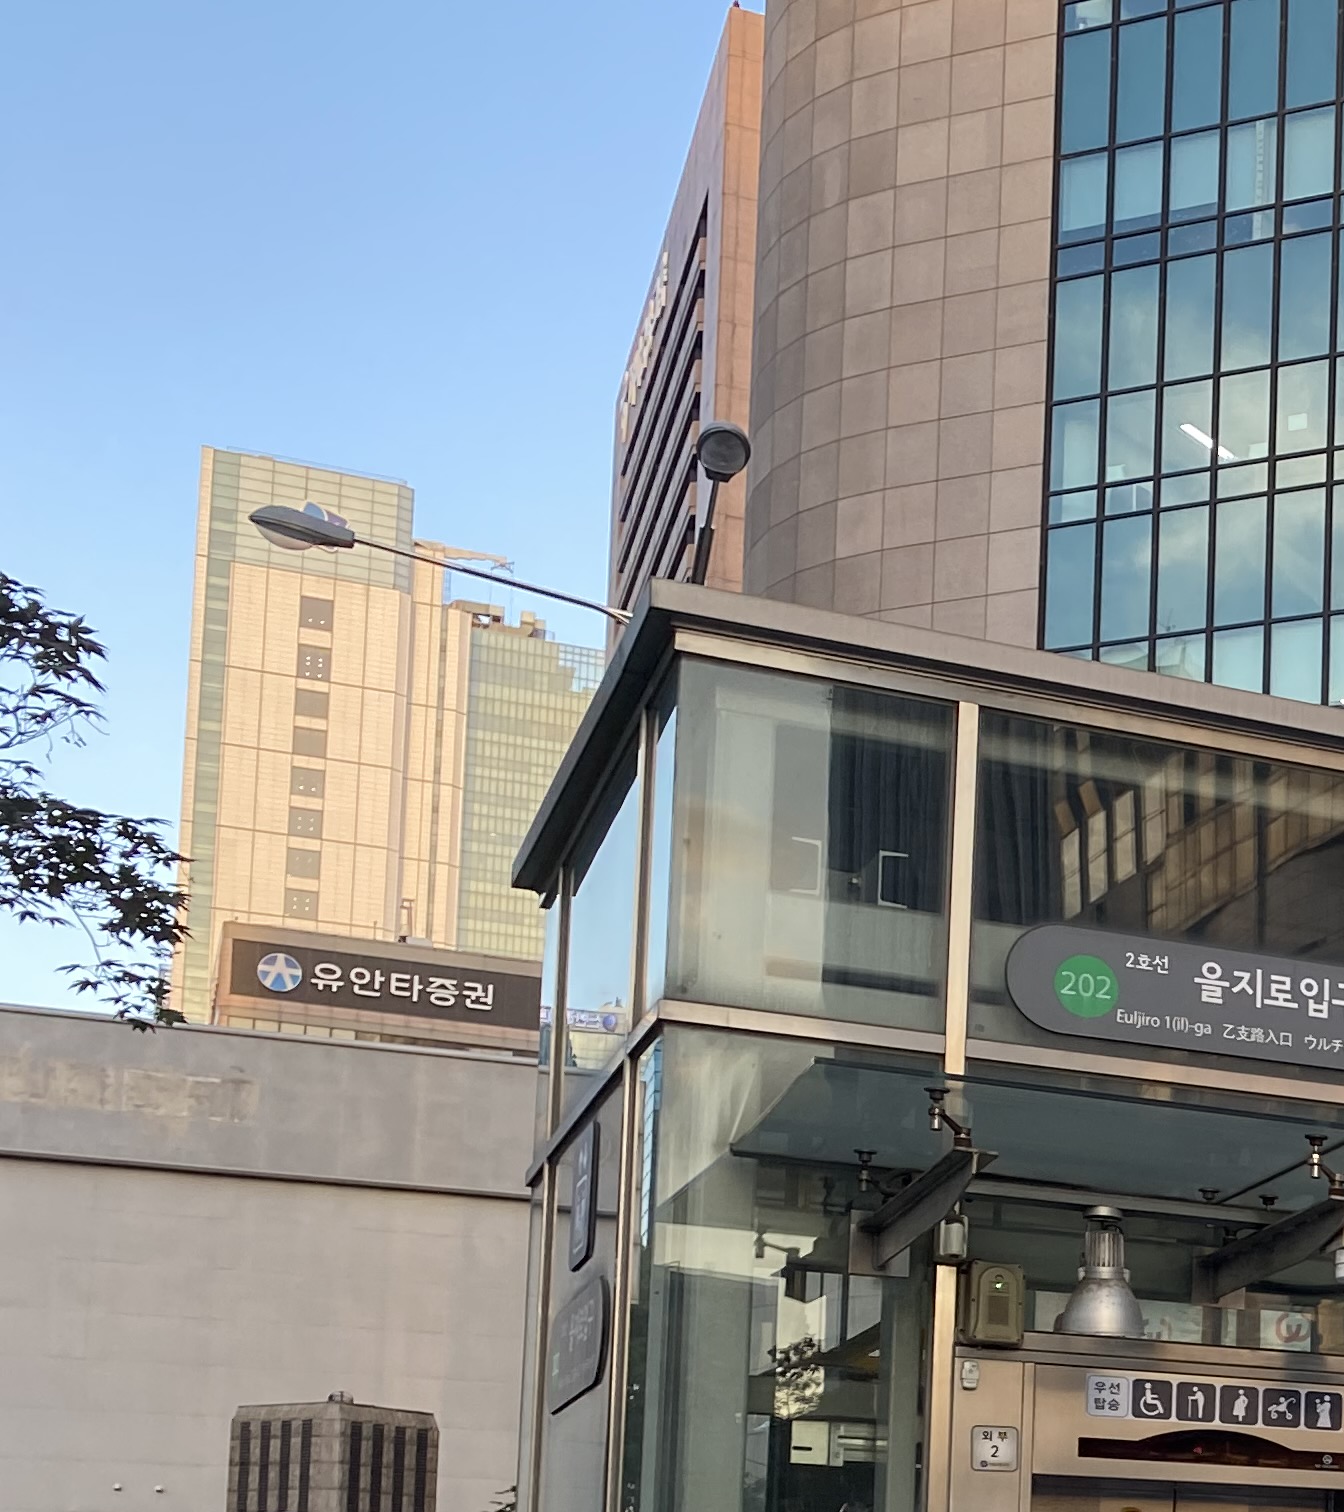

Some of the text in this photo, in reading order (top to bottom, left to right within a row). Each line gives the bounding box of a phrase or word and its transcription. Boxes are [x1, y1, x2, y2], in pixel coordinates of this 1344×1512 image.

[1125, 951, 1170, 975] 2호선
[310, 962, 495, 1011] 유안타증권
[1060, 970, 1112, 1000] 202
[1116, 1008, 1212, 1037] Euljiro 1(il)-ga
[1223, 1023, 1293, 1047] 乙支路入口
[1093, 1381, 1121, 1395] 우선
[1093, 1397, 1121, 1411] 탑승
[990, 1444, 999, 1458] 2
